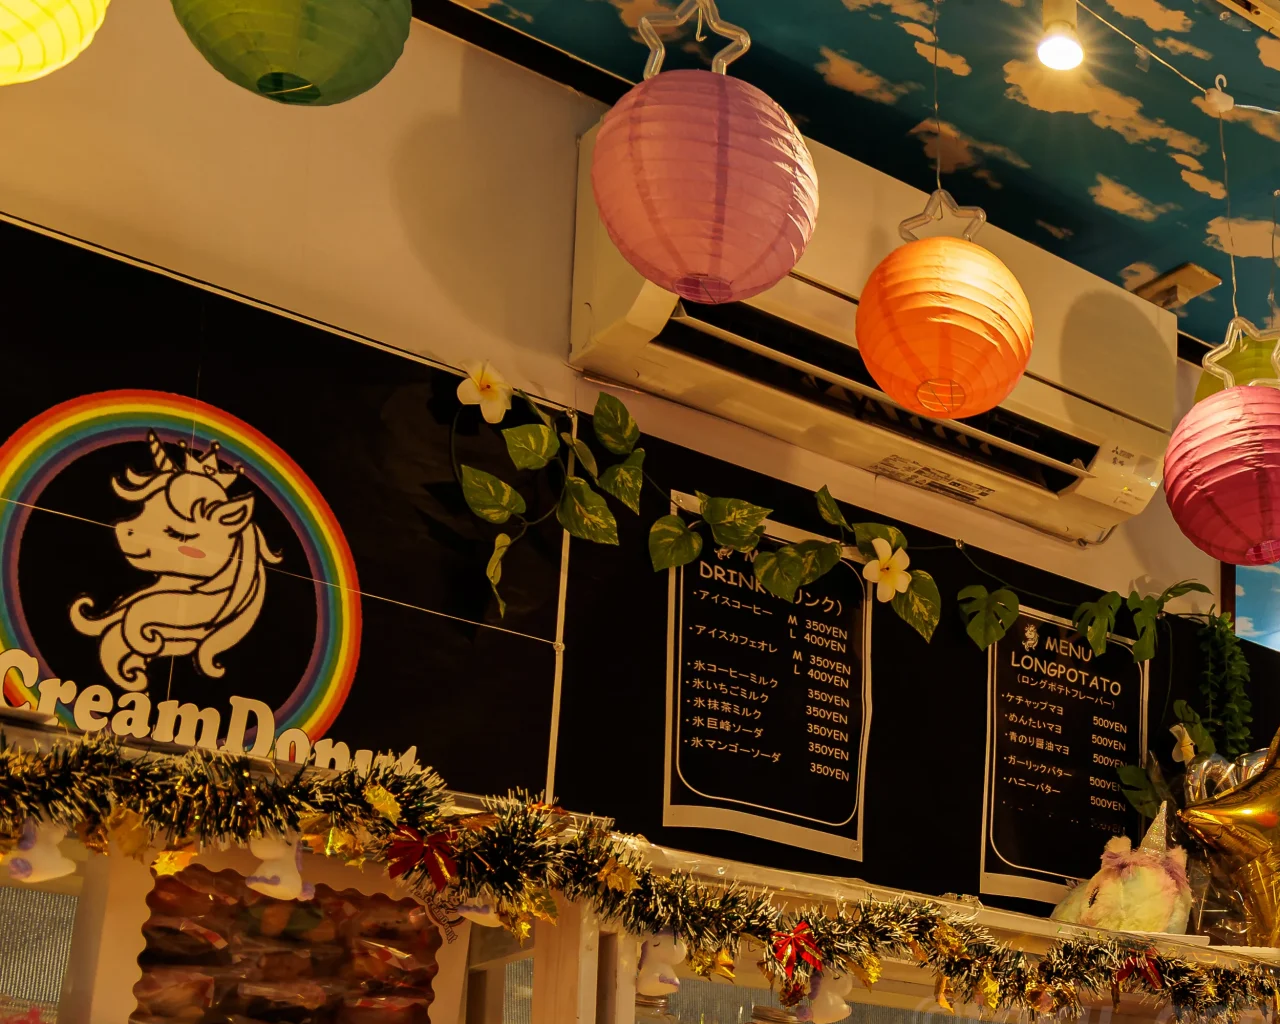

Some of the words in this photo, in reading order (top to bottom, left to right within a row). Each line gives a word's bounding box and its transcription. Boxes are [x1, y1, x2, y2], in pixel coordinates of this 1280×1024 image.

[698, 590, 773, 615] アイスコーヒー
[695, 624, 778, 653] アイスカフェオレ
[788, 615, 798, 626] M
[805, 619, 848, 640] 350YEN
[789, 628, 797, 639] L
[803, 633, 847, 653] 400YEN
[792, 649, 803, 661] M
[809, 654, 852, 676] 350YEN
[1045, 636, 1092, 662] MENU
[693, 660, 778, 689] 氷コーヒーミルク
[807, 688, 850, 708] 350YEN
[794, 664, 801, 675] L
[807, 669, 849, 689] 400YEN
[1011, 650, 1121, 696] LONGPOTATO
[692, 678, 769, 703] 氷いちごミルク
[805, 705, 848, 725] 350YEN
[1006, 692, 1064, 716] ケチャップマヨ
[1092, 715, 1127, 734] 500YEN
[693, 696, 762, 720] 氷抹茶ミルク
[806, 723, 849, 743] 350YEN
[1008, 712, 1062, 735] めんたいマヨ
[1091, 734, 1127, 752] 500YEN
[692, 716, 764, 738] 氷巨峰ソーダ
[808, 741, 849, 761] 350YEN
[1008, 731, 1069, 755] 青のり醤油マヨ
[690, 736, 782, 763] 氷マンゴーソーダ
[809, 762, 850, 782] 350YEN
[1008, 755, 1073, 777] ガーリックバター
[1008, 777, 1061, 794] ハニーバター
[1090, 795, 1127, 812] 500YEN
